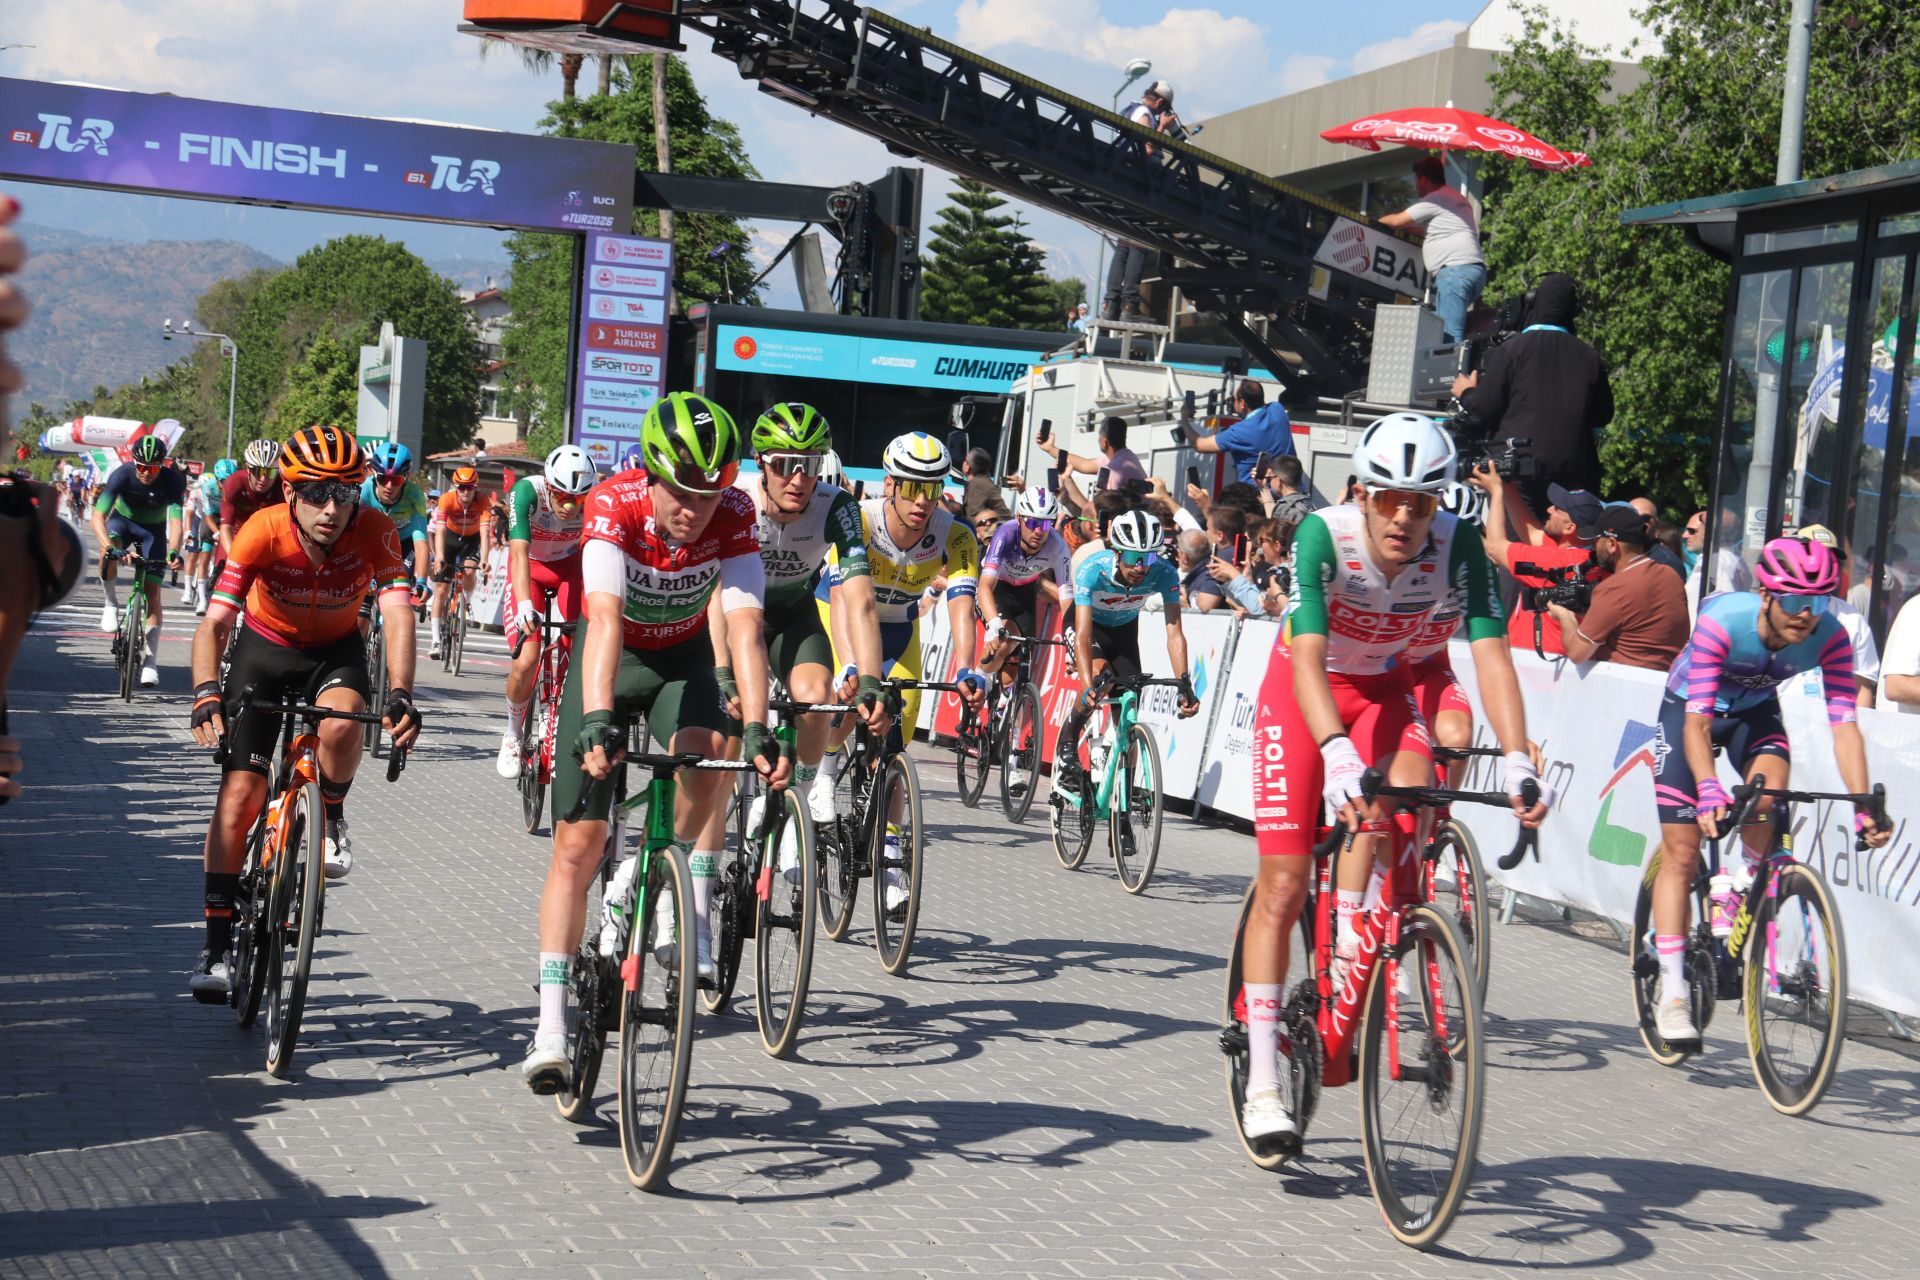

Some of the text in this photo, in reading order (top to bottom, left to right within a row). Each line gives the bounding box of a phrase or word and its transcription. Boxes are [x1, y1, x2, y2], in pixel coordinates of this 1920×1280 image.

[11, 131, 35, 144] 61.
[38, 113, 115, 155] TUR
[179, 132, 346, 178] FINISH
[406, 172, 429, 185] 61.
[430, 155, 500, 195] TUR
[614, 339, 656, 349] AIRLINES
[615, 329, 656, 340] TURKISH
[934, 356, 1028, 381] CUMHURB
[609, 390, 639, 398] Telekom
[835, 506, 855, 542] RGA
[760, 550, 801, 561] CAJA
[762, 560, 809, 571] URAL
[657, 566, 718, 592] RURAL
[1336, 606, 1422, 630] POLTI
[1264, 725, 1288, 801] POLTI
